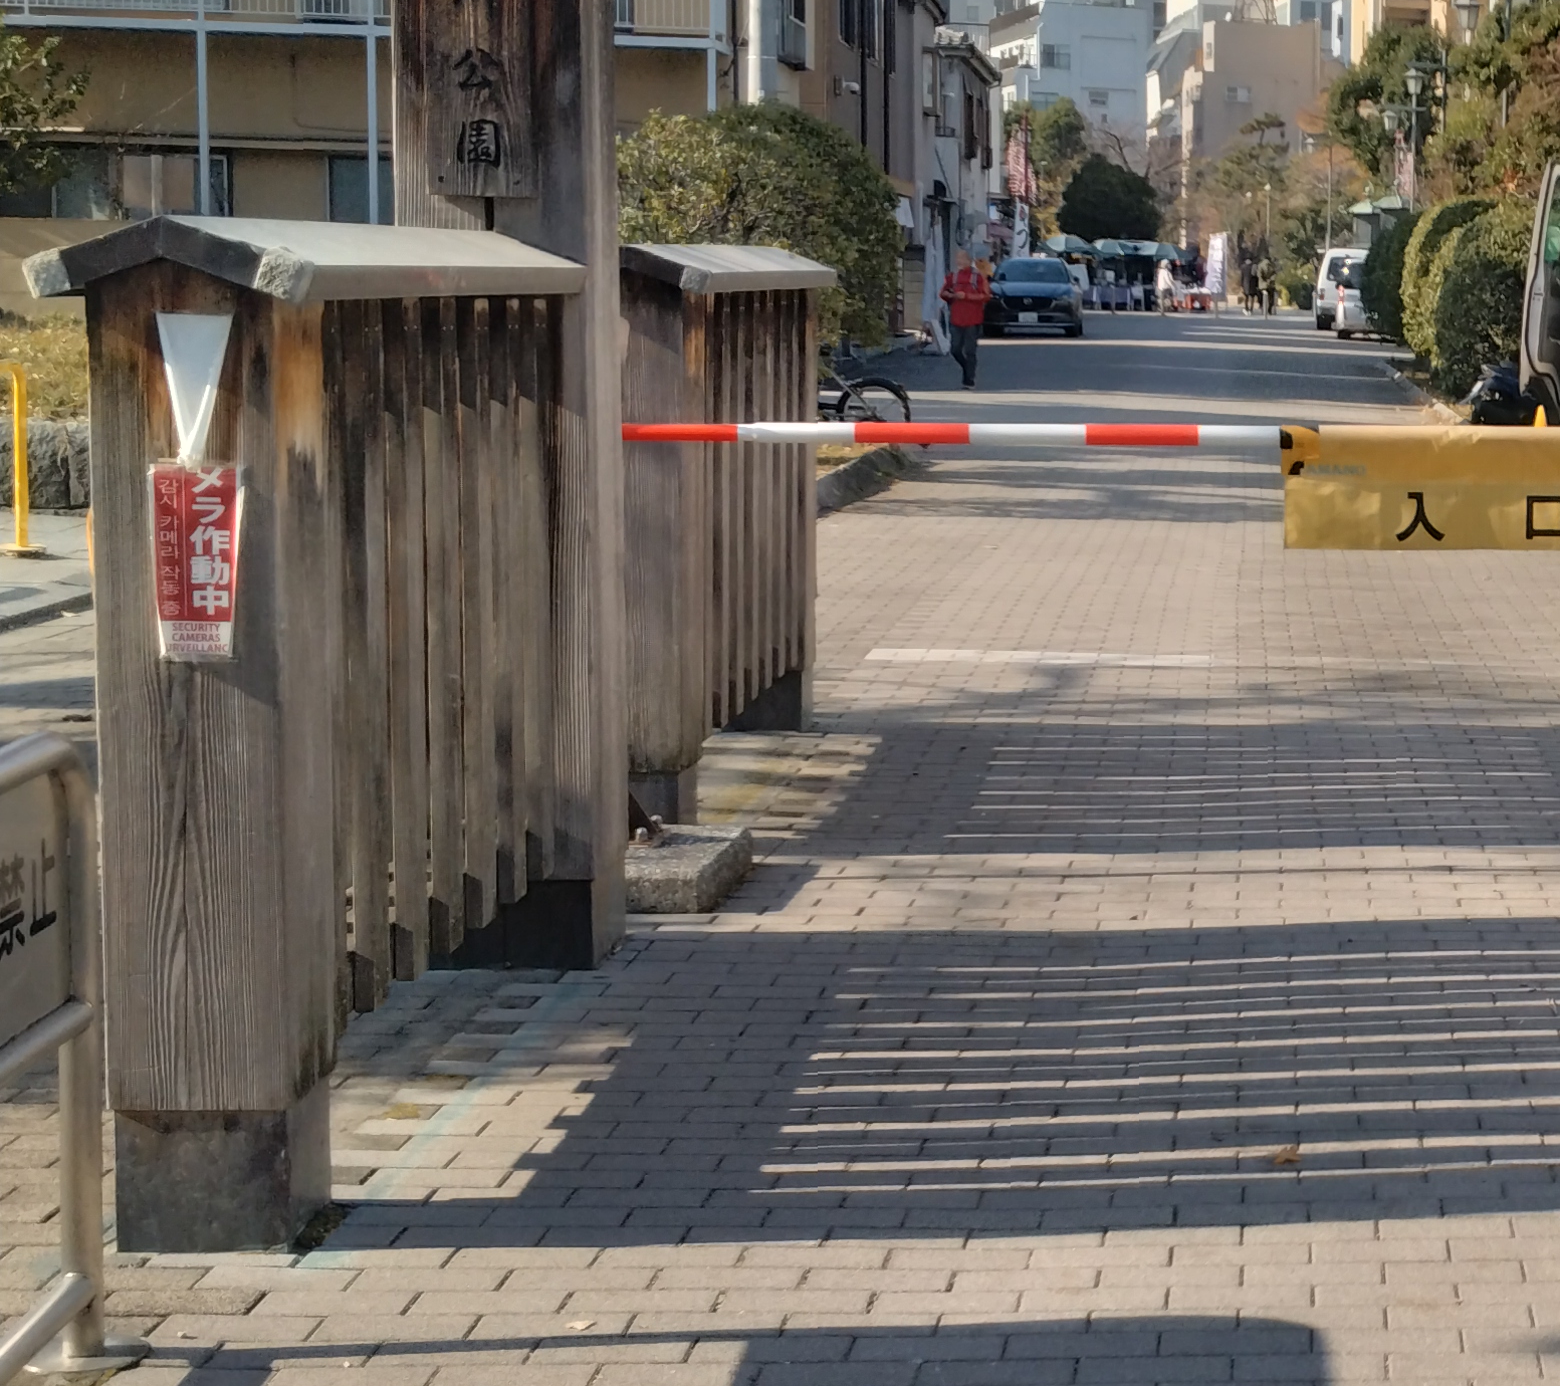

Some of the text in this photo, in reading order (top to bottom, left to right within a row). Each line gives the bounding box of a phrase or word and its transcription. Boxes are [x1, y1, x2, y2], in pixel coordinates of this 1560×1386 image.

[158, 479, 182, 616] 감시 카메라 작동 중
[190, 468, 230, 616] メラ作動中
[171, 622, 221, 633] SECURITY
[171, 633, 221, 643] CAMERAS
